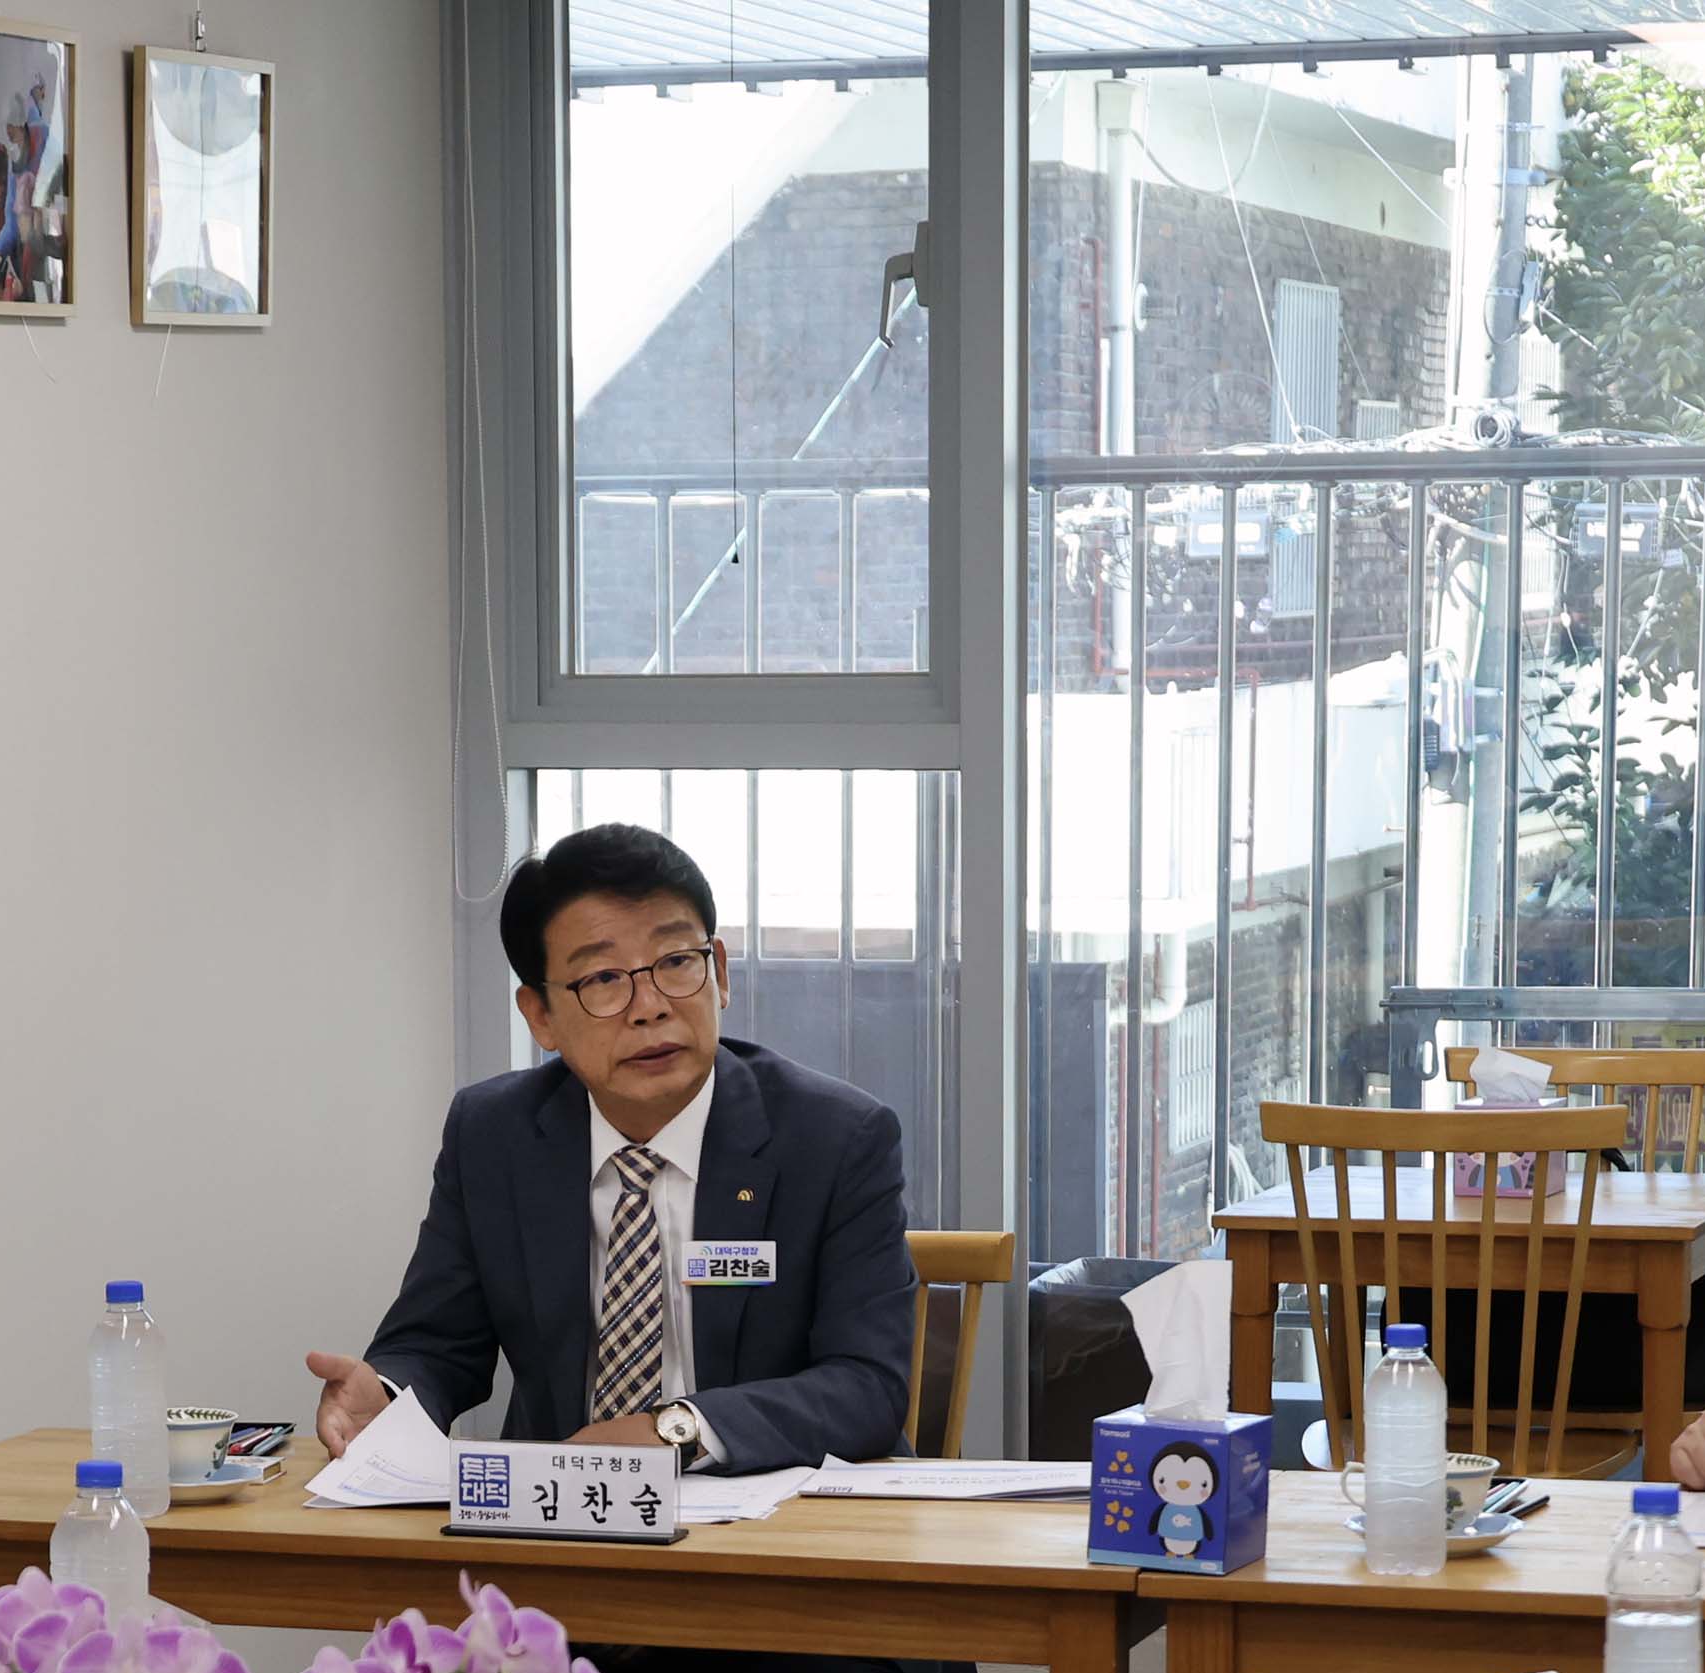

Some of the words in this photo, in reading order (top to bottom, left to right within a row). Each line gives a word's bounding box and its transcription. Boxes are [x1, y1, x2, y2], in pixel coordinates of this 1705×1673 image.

[709, 1258, 770, 1277] 김찬술
[552, 1455, 643, 1473] 대덕구청장
[461, 1481, 509, 1505] 대덕
[532, 1479, 663, 1527] 김찬술
